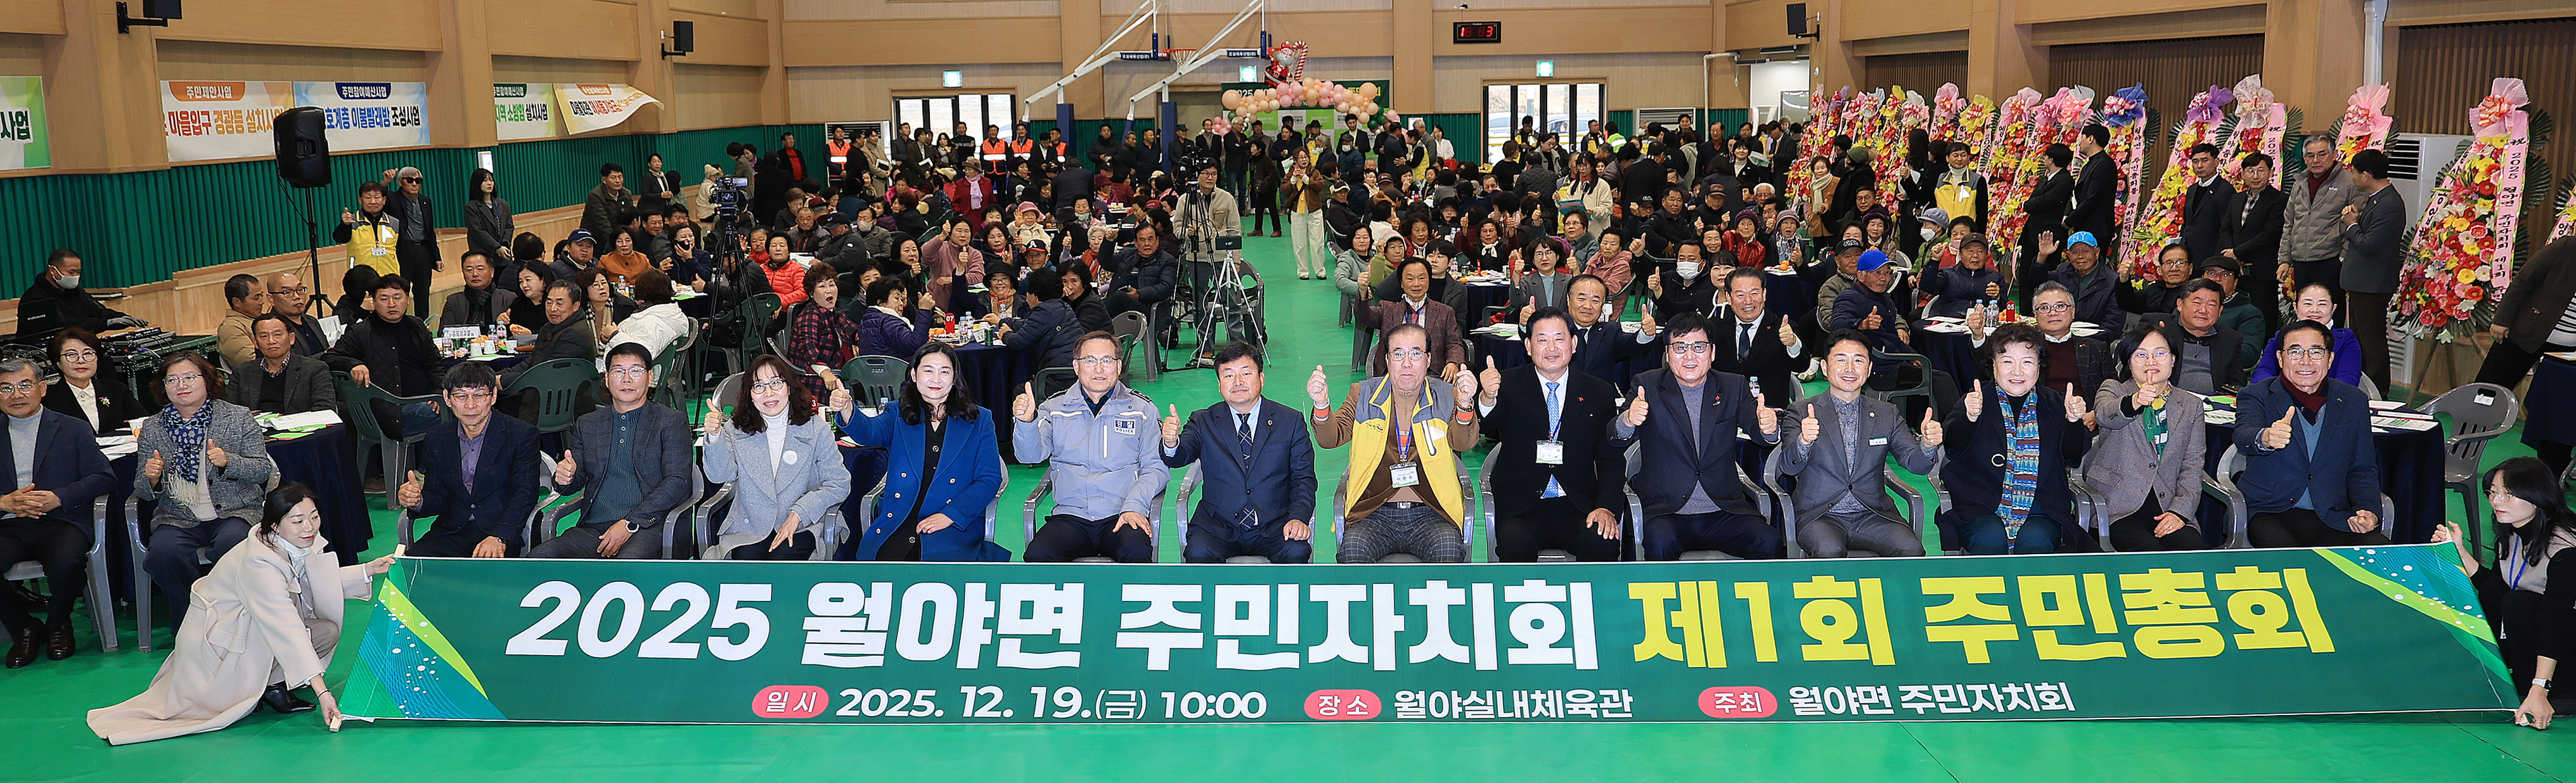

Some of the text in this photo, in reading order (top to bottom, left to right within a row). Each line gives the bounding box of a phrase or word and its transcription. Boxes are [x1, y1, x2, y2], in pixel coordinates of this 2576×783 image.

[186, 86, 232, 99] 주민제안사업
[342, 86, 387, 98] 주민참여예산사업
[168, 110, 212, 136] 마을입구
[213, 109, 244, 135] 경광등
[325, 105, 421, 129] 호계층 이불빨래방 조성사업
[525, 103, 548, 121] 설치사업
[2508, 152, 2521, 179] 2025
[505, 566, 2336, 671] 2025 월야면 주민자치회 제1회 주민총회
[835, 688, 944, 717] 2025.
[960, 685, 1014, 718] 12.
[1161, 691, 1267, 719] 10:00
[1394, 689, 1633, 719] 월야실내체육관
[1714, 692, 1763, 713] 주최
[1789, 682, 2076, 715] 월야면 주민자치회
